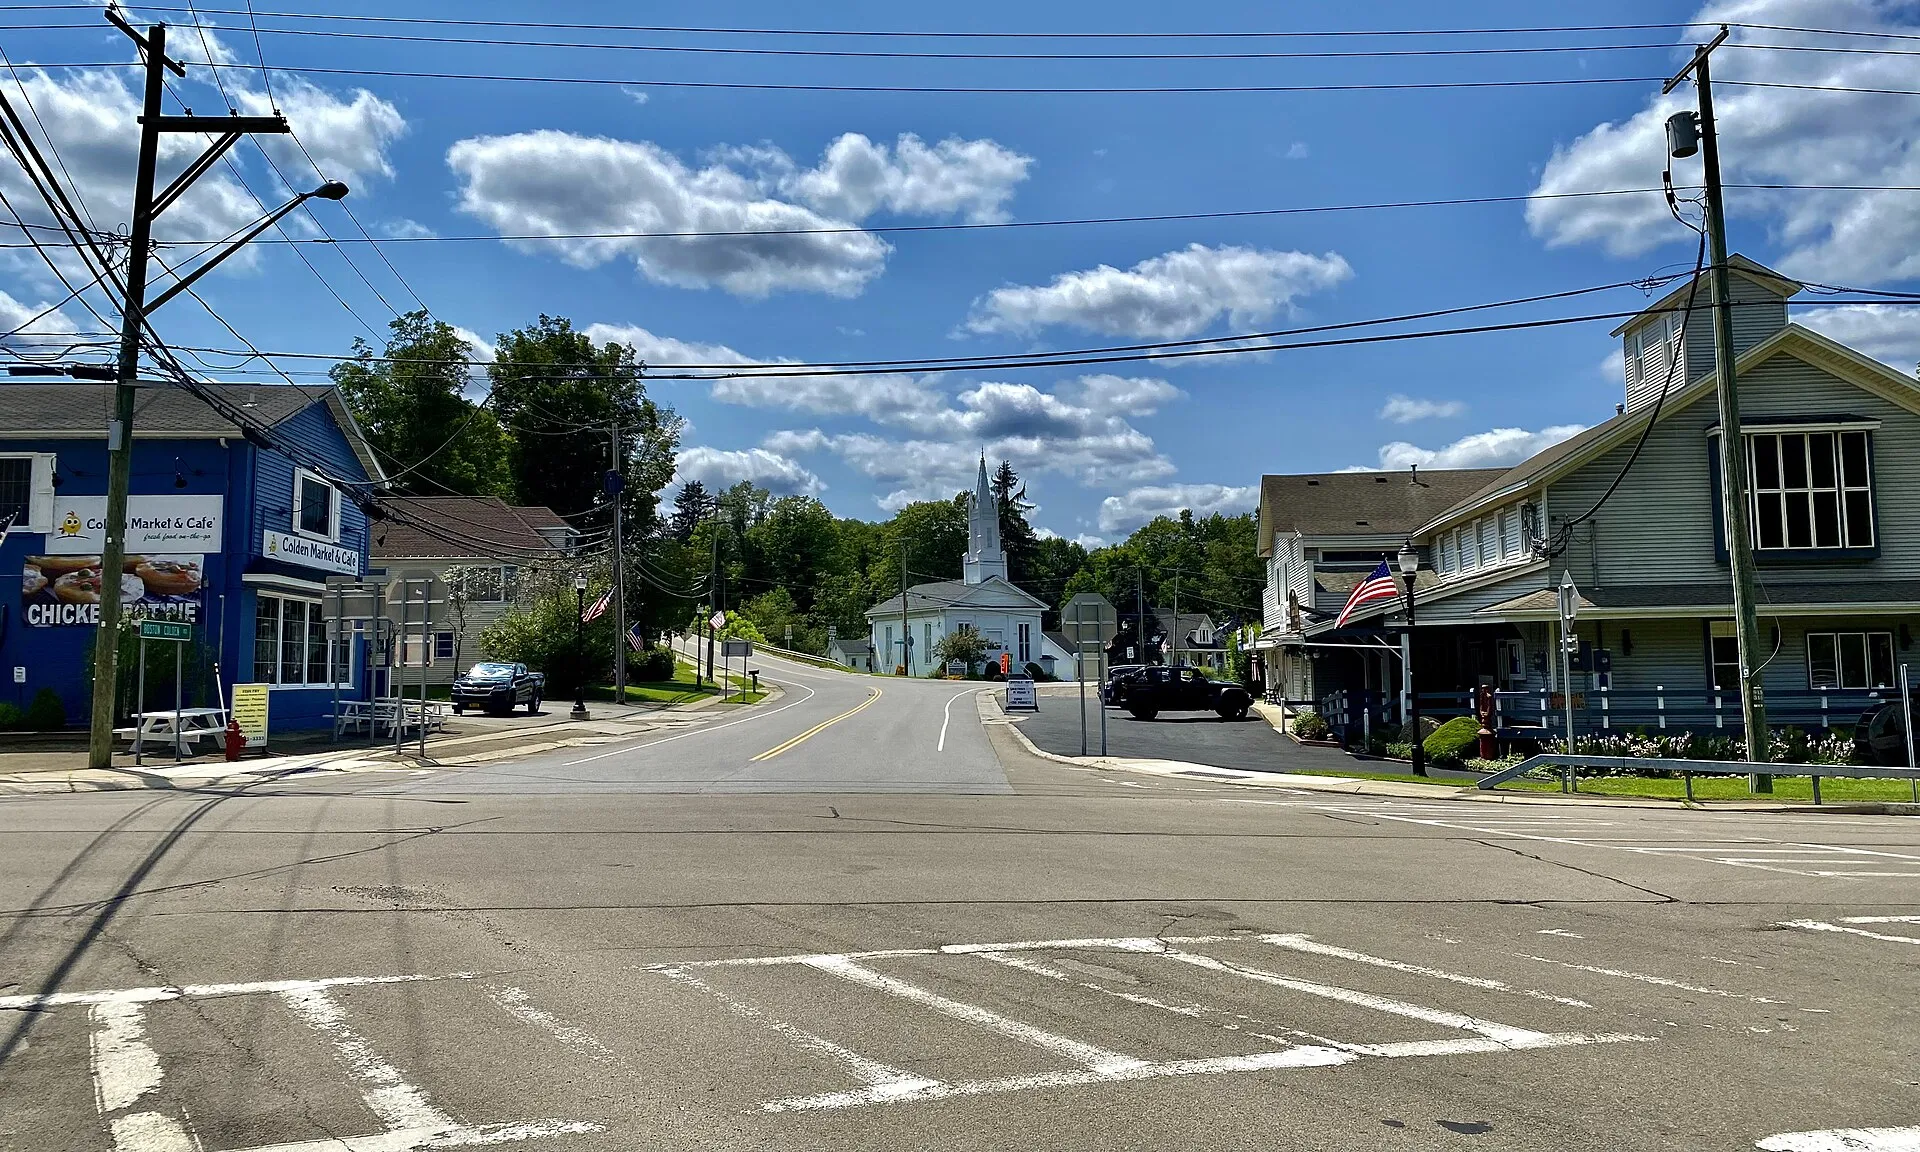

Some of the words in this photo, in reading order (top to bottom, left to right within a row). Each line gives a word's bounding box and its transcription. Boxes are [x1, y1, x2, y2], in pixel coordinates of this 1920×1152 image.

[86, 518, 128, 529] Col
[131, 518, 171, 529] Market
[174, 518, 184, 529] &
[144, 533, 161, 541] fresh
[162, 532, 177, 541] food
[179, 533, 211, 541] on-the-go
[282, 537, 309, 557] Colden
[311, 543, 334, 562] Market
[335, 553, 340, 564] &
[28, 604, 100, 625] CHICKE
[167, 603, 195, 622] PIE
[143, 624, 160, 635] BOSTON
